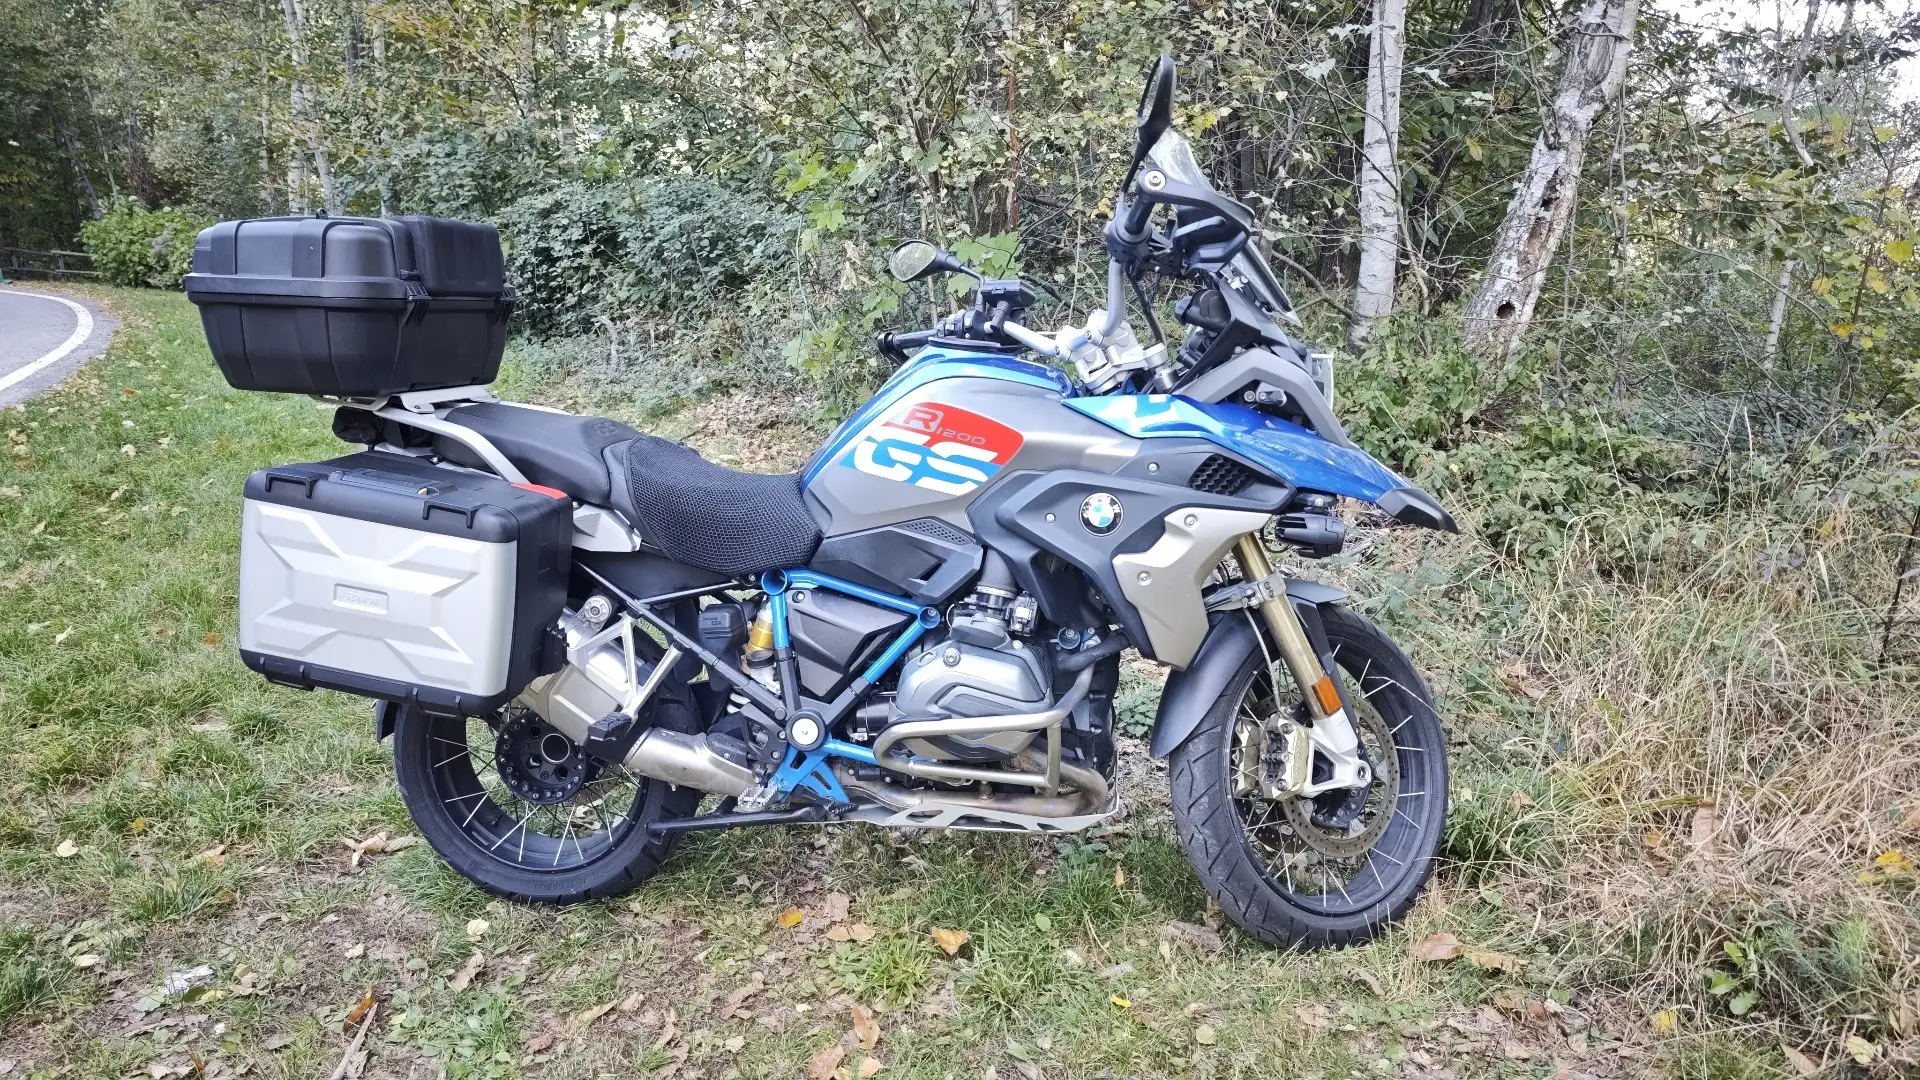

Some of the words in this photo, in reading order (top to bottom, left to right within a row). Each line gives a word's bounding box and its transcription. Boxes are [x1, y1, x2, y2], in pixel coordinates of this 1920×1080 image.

[903, 406, 945, 432] R
[935, 428, 986, 445] 1200
[853, 435, 999, 496] GS
